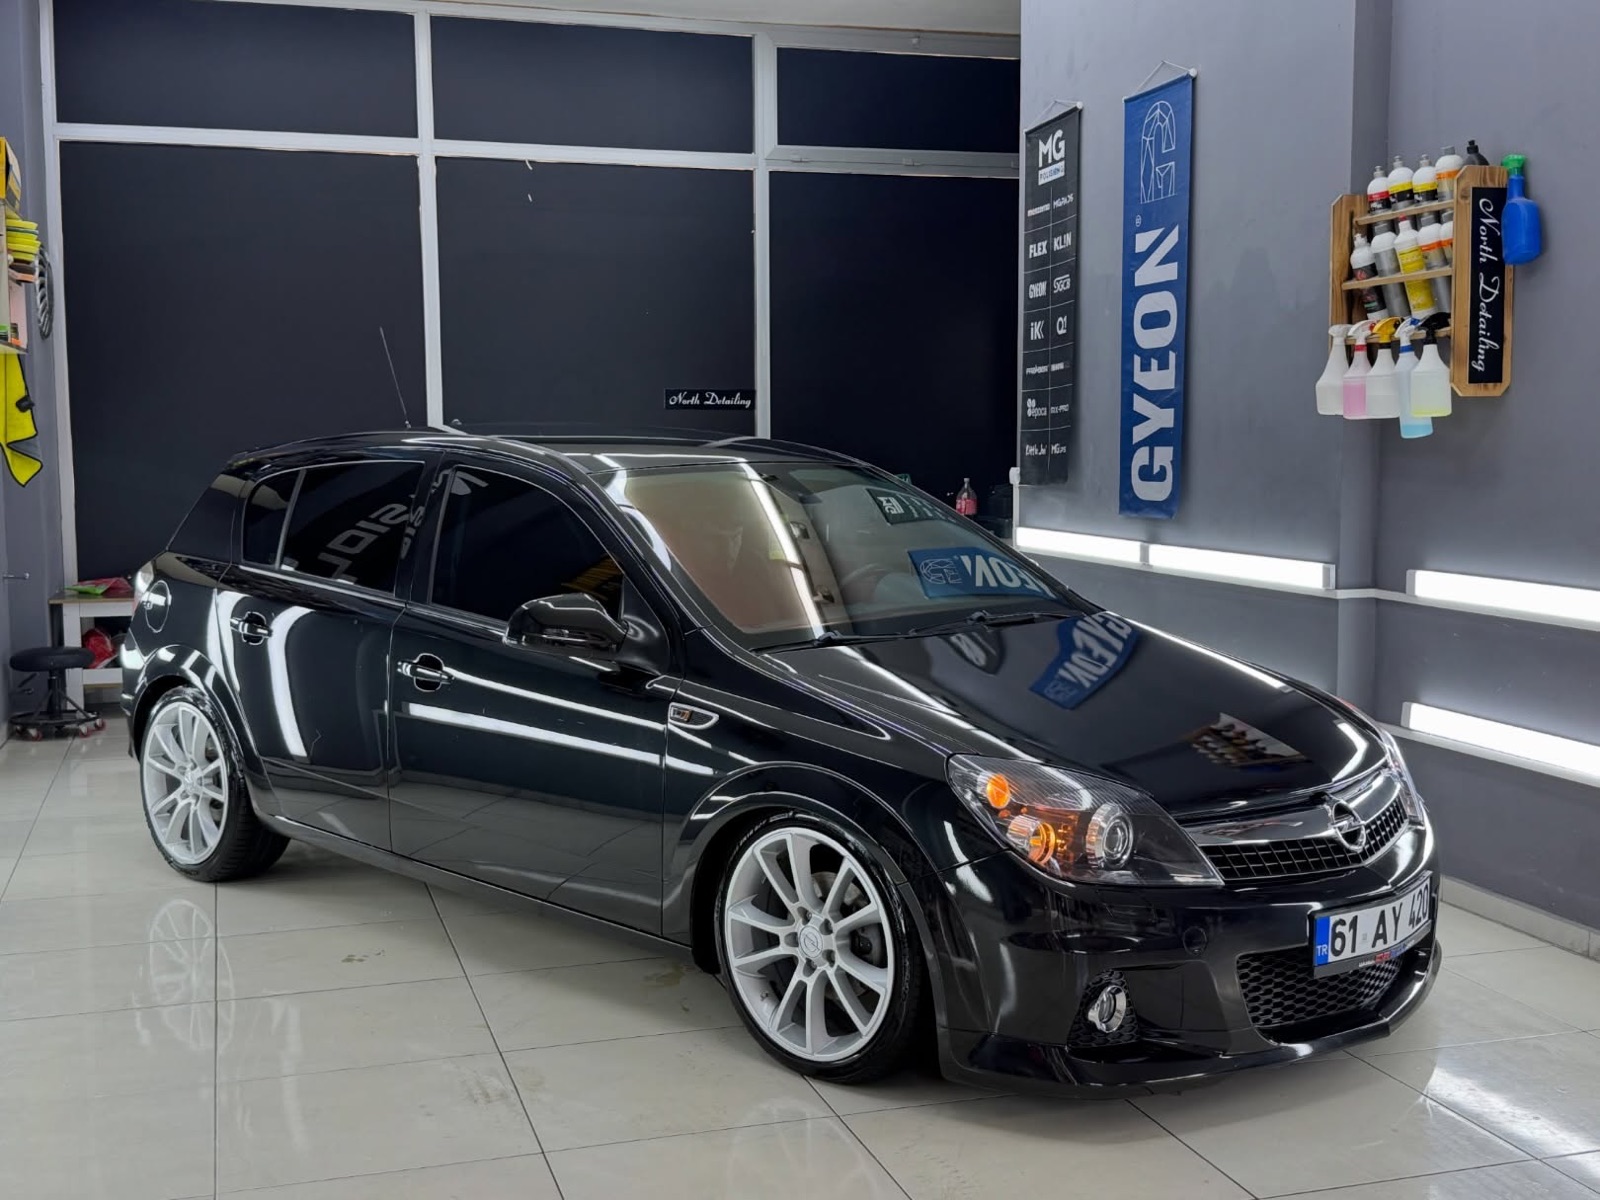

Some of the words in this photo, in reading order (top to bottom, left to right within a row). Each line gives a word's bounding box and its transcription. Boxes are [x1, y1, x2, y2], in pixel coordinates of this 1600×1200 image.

[1038, 129, 1065, 168] MG
[1028, 240, 1048, 259] FLEX
[1053, 231, 1072, 252] KLIN
[1478, 198, 1501, 264] North
[1471, 271, 1501, 373] Detailing
[1130, 224, 1180, 503] GYEON
[668, 391, 700, 406] North
[703, 391, 752, 409] Detailing
[1316, 944, 1329, 957] TR
[1330, 914, 1359, 957] 61
[1371, 901, 1403, 949] AY
[1408, 883, 1429, 930] 420
